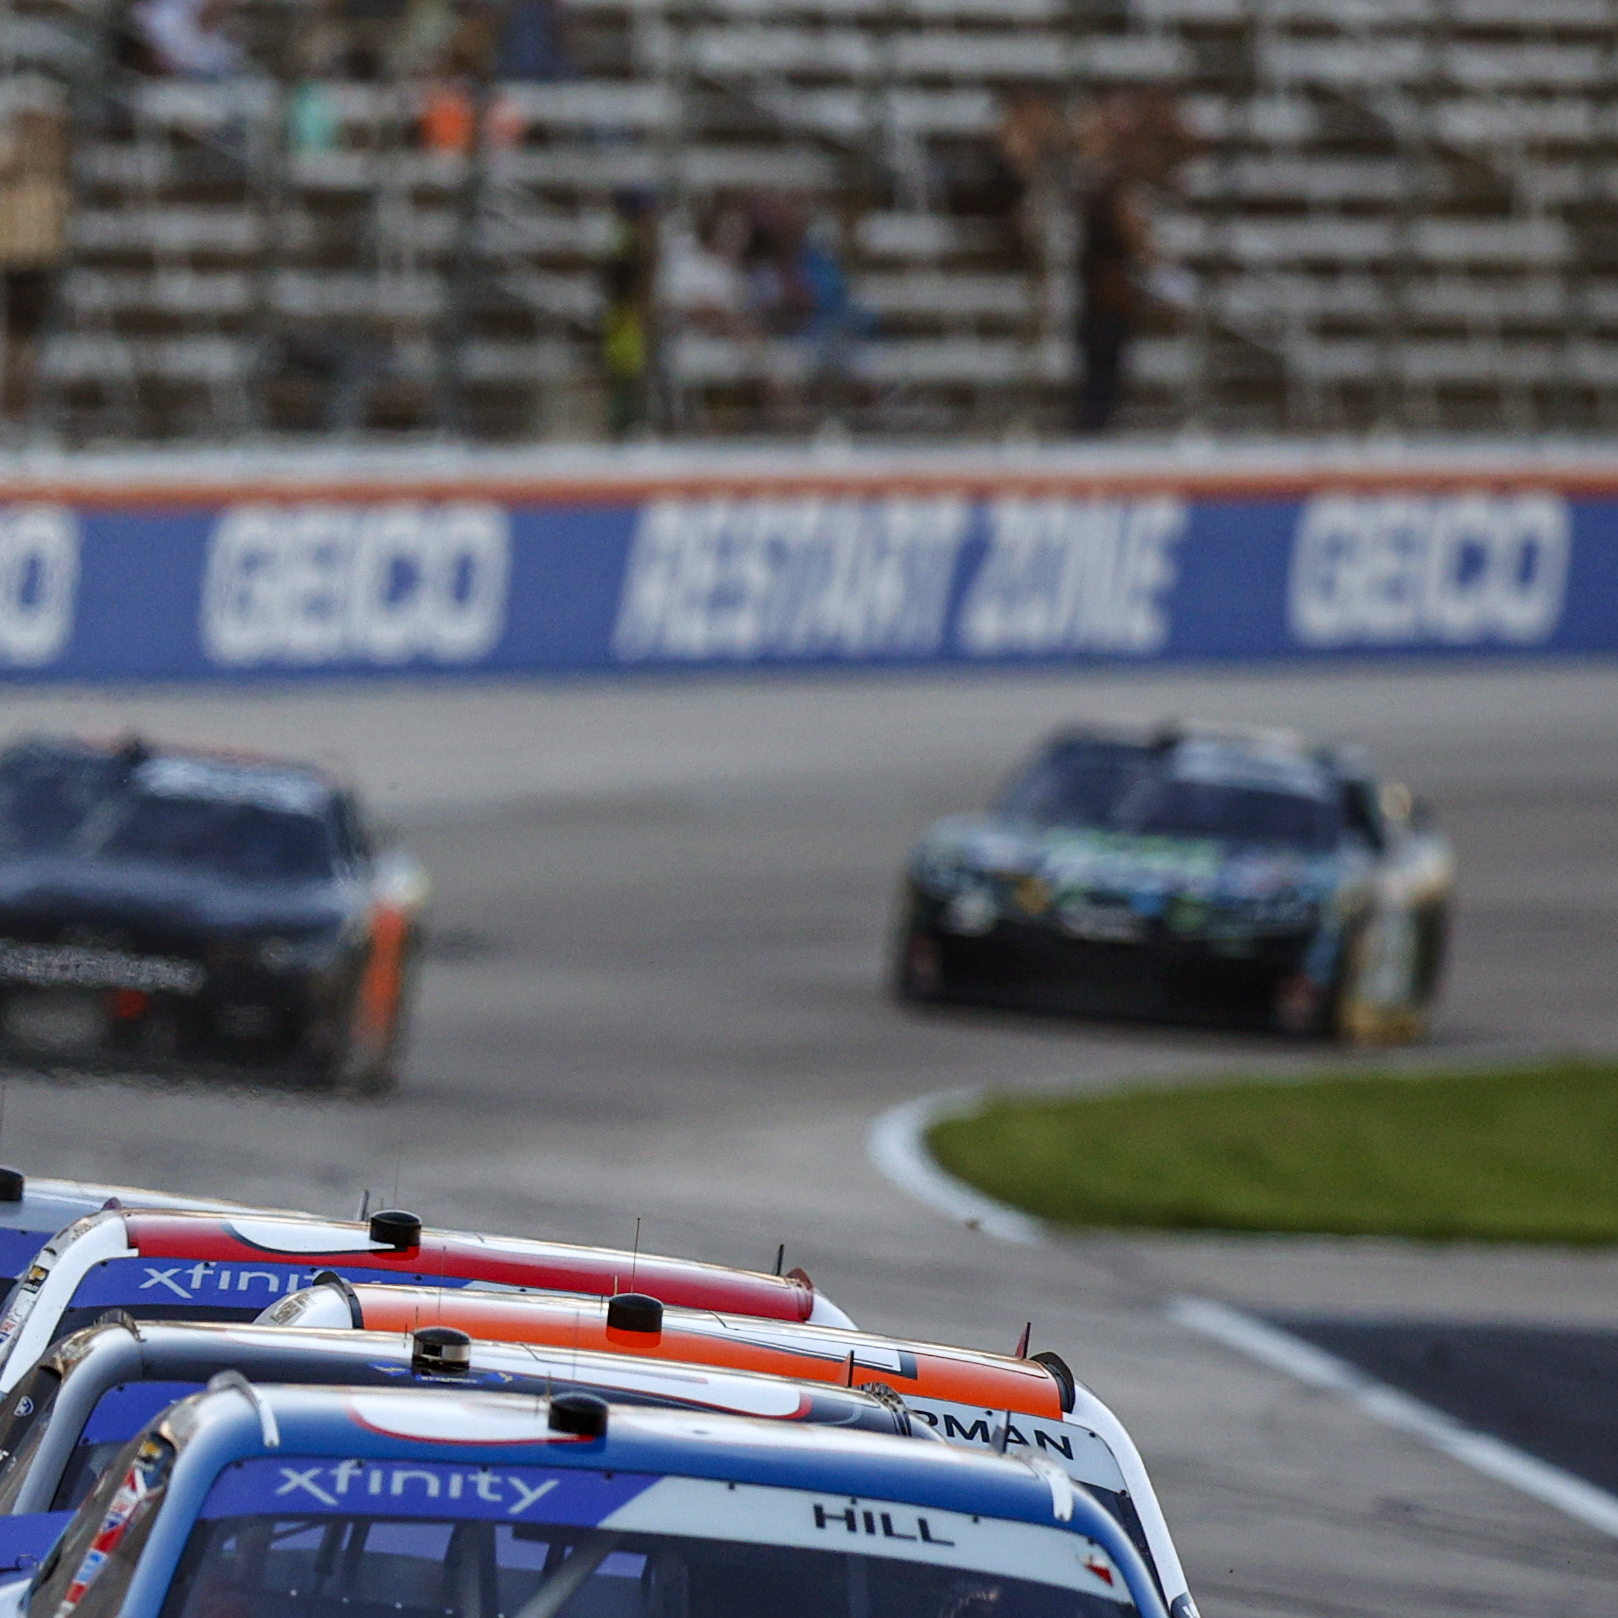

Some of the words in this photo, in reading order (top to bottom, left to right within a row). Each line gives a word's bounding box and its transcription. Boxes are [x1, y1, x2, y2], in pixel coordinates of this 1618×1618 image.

[202, 500, 511, 667] GEICO
[612, 497, 965, 660] RESTART
[959, 496, 1190, 655] ZONE
[1287, 493, 1571, 648] GEICO
[138, 1262, 313, 1299] xfini
[275, 1458, 560, 1515] xfinity
[813, 1503, 955, 1547] HILL
